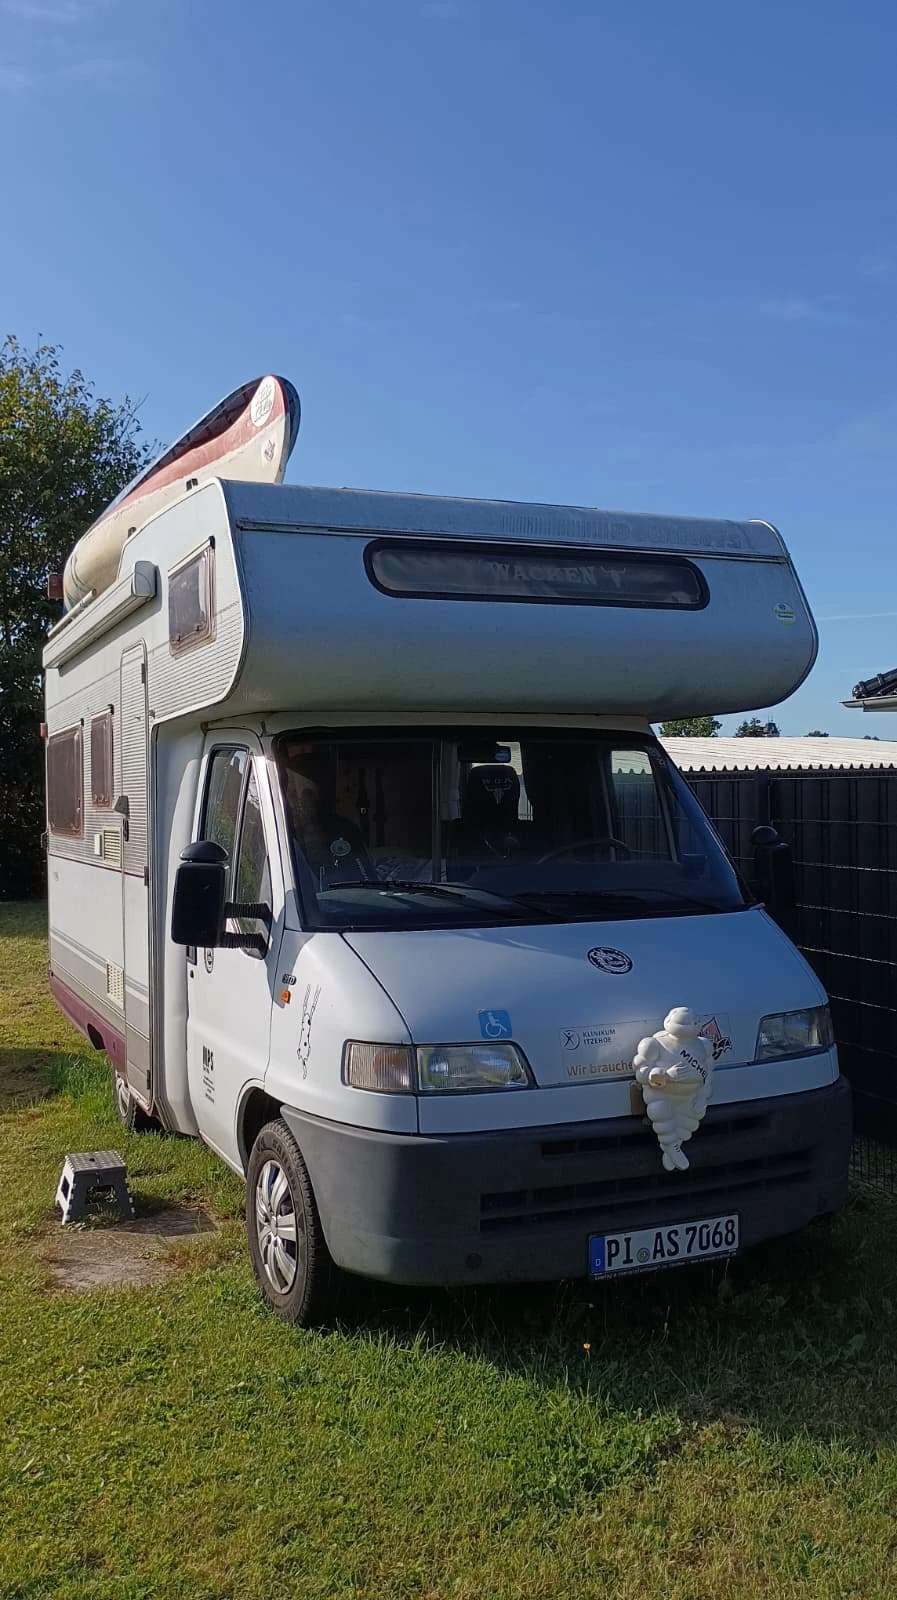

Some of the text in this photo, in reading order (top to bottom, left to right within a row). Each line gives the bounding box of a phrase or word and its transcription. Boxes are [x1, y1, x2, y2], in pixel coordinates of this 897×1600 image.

[489, 560, 596, 585] WACKEN
[582, 1028, 616, 1038] KLINIKUM
[583, 1036, 613, 1045] ITZEHOE
[567, 1064, 587, 1077] Wir
[606, 1237, 634, 1268] PI
